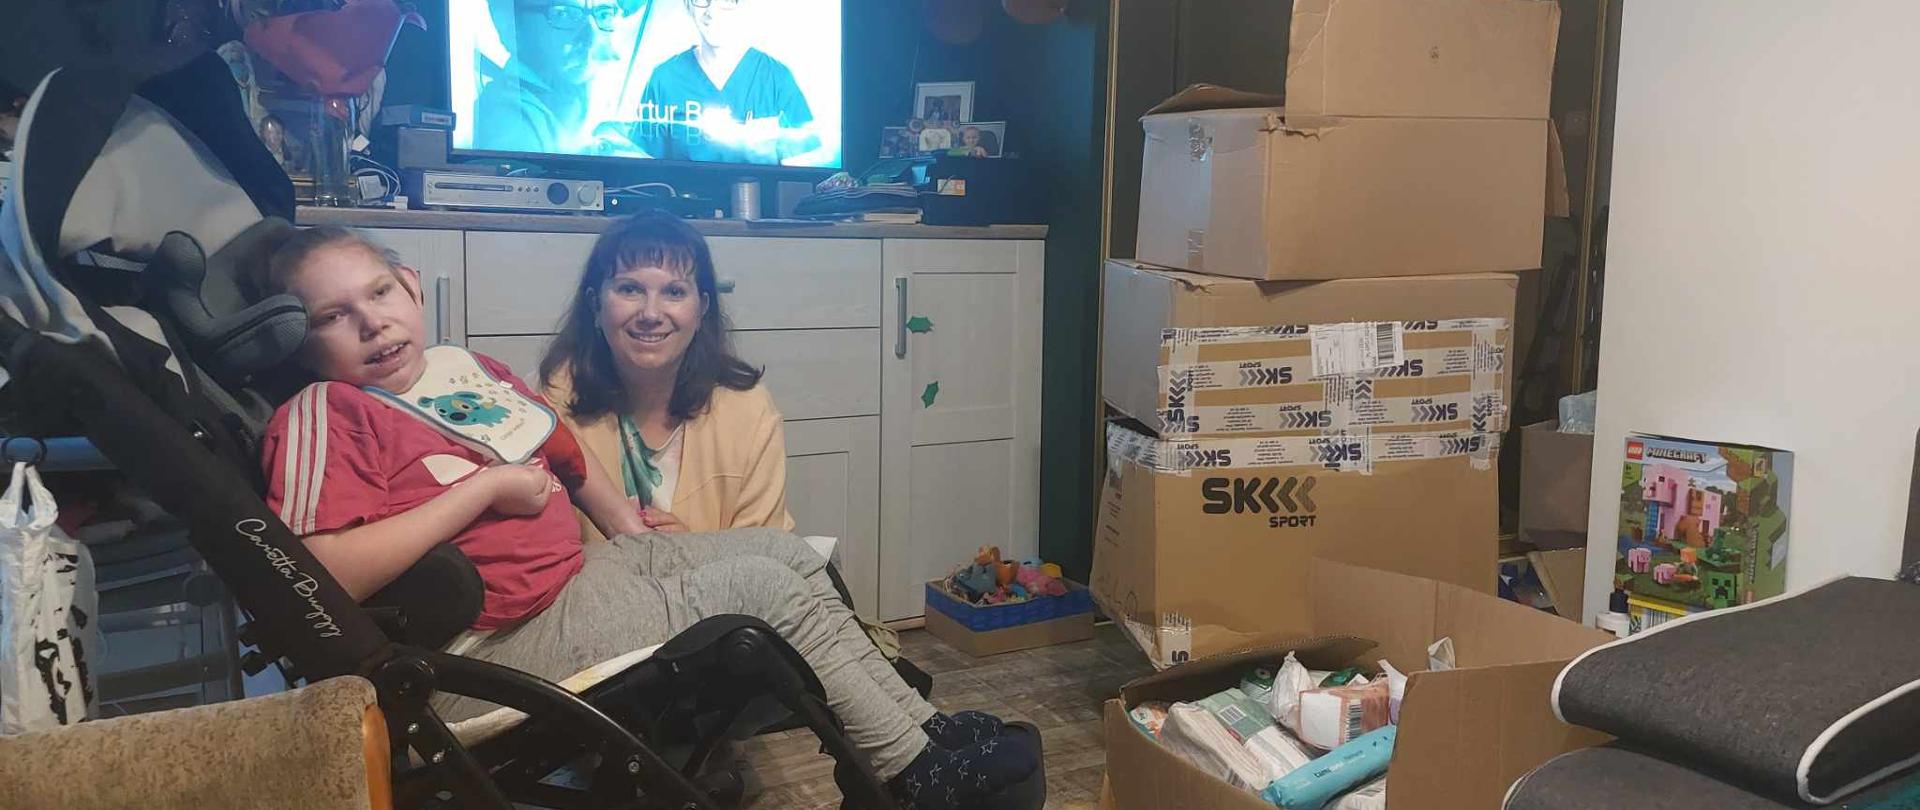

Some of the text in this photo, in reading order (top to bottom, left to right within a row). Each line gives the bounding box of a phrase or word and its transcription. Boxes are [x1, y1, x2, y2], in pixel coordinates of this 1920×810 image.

[1202, 477, 1262, 514] SK
[1269, 515, 1317, 528] SPORT
[235, 518, 343, 637] Caretta Buggy
